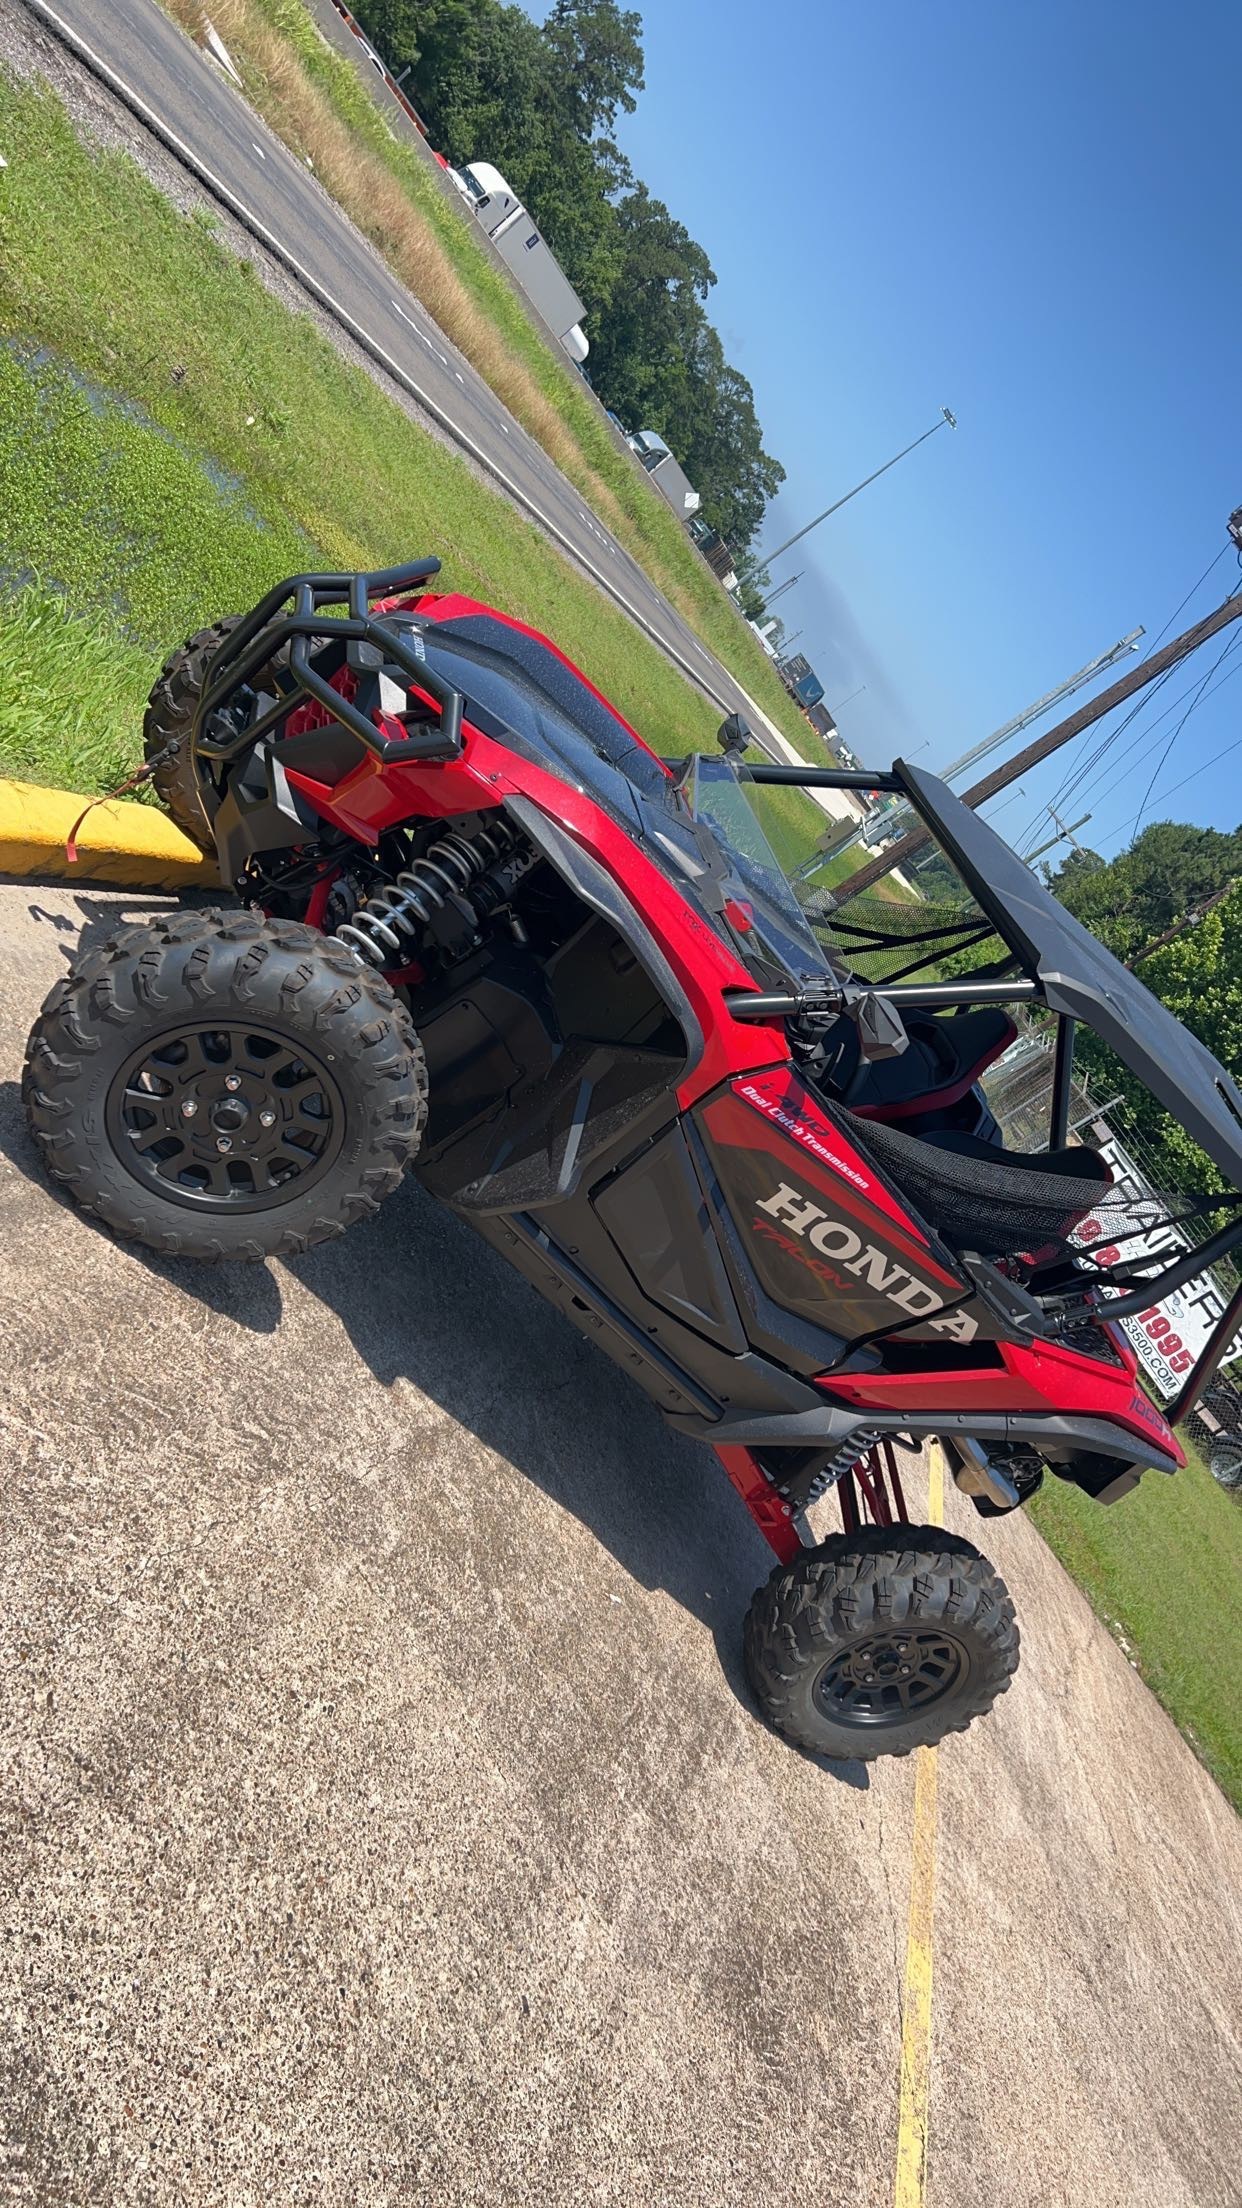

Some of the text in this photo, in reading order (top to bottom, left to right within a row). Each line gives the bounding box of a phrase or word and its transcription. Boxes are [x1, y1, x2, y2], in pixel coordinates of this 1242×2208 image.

[413, 634, 426, 662] HOND
[740, 1085, 871, 1190] Dual Clutch Transmission
[752, 1216, 855, 1290] TALON
[755, 1181, 979, 1346] HONDA
